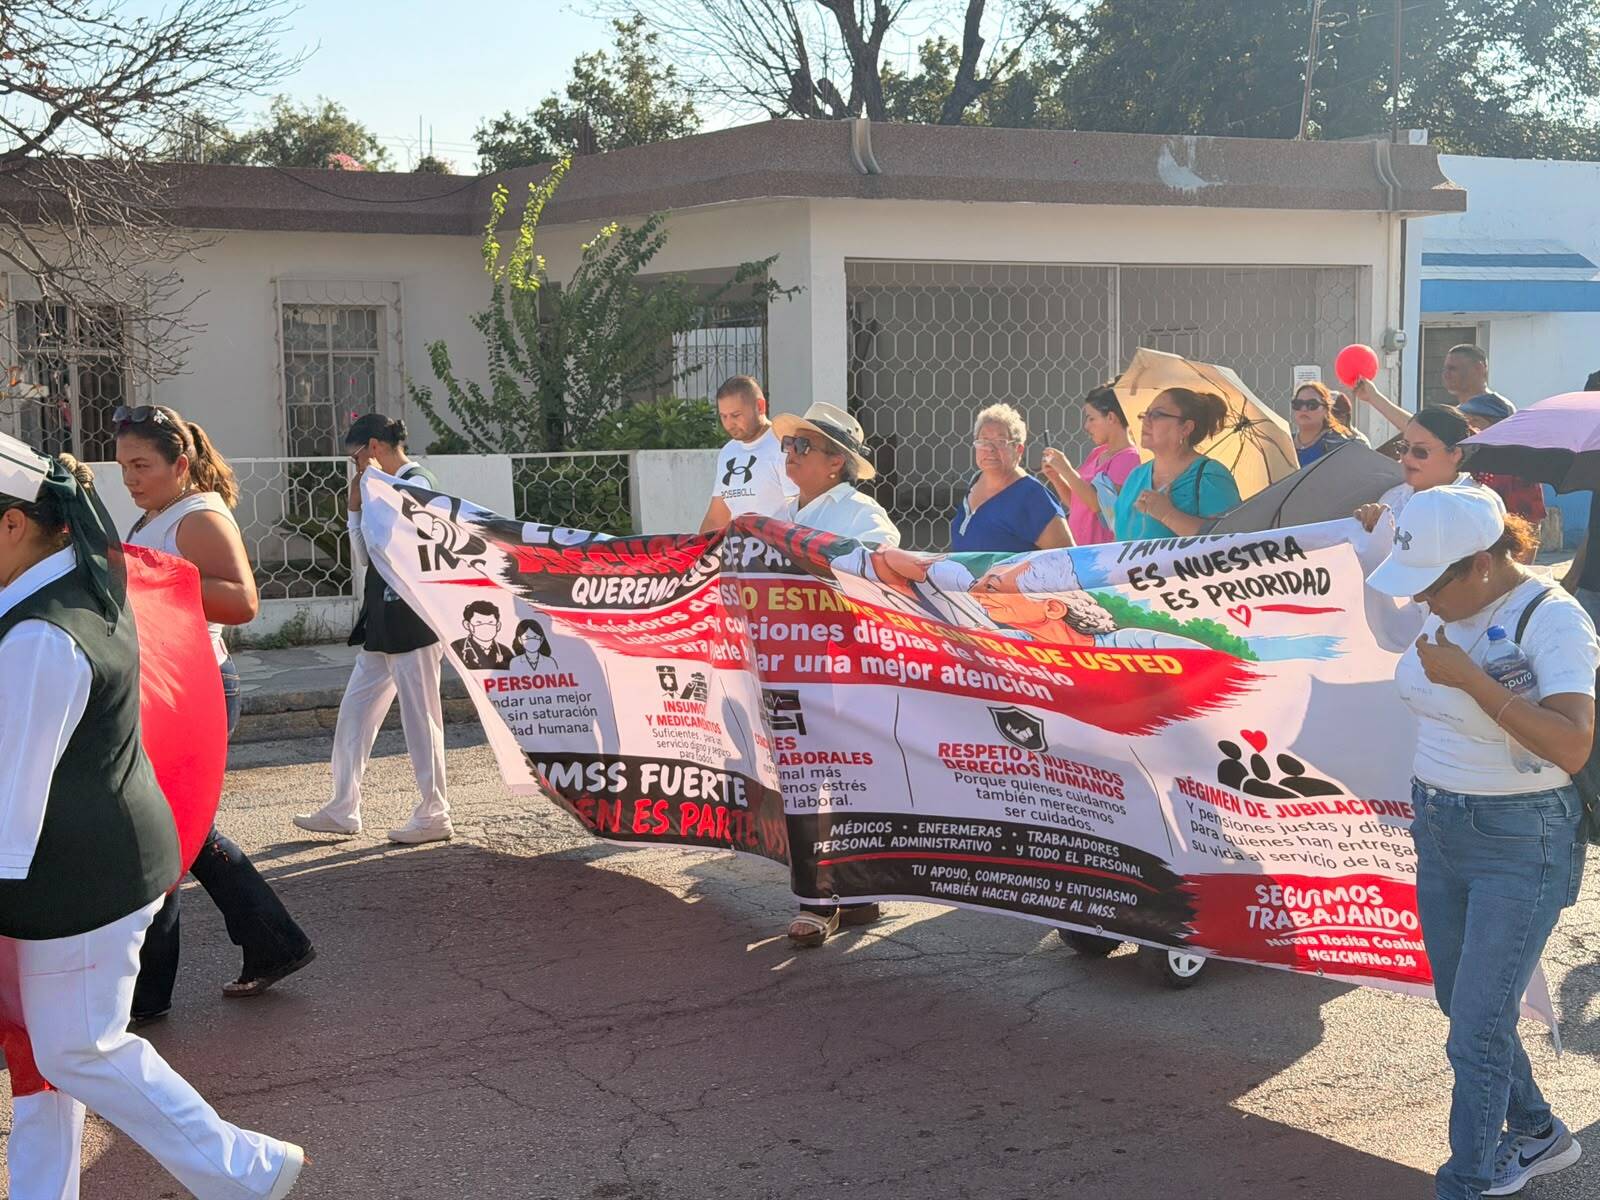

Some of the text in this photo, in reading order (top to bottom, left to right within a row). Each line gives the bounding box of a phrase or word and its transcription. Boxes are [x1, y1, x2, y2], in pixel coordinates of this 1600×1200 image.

[1127, 535, 1307, 592] ES NUESTRA
[572, 576, 681, 605] QUEREMO
[1160, 567, 1330, 612] ES PRIORIDAD
[853, 619, 938, 652] dignas
[941, 639, 973, 661] de
[974, 649, 1074, 686] trabajo
[1024, 645, 1072, 667] DE
[1072, 652, 1183, 675] USTED
[483, 673, 579, 693] PERSONAL
[794, 654, 851, 673] una
[861, 652, 933, 683] mejor
[940, 663, 1054, 701] atención
[507, 705, 598, 722] sin saturación
[529, 695, 552, 706] una
[556, 691, 592, 705] mejor
[538, 723, 593, 735] humana.
[645, 714, 653, 726] Y
[778, 751, 873, 765] ABORALES
[810, 766, 842, 778] más
[938, 743, 1124, 787] RESPETO A NUESTROS
[640, 764, 749, 809] FUERTE
[782, 779, 867, 794] enos estrés
[943, 759, 1125, 801] DERECHOS HUMANOS
[954, 771, 1127, 816] Porque quienes cuidamos
[793, 795, 853, 809] laboral.
[976, 786, 1115, 824] también merecemos
[1175, 776, 1242, 816] RÉGIMEN
[1244, 799, 1272, 819] DE
[632, 799, 669, 836] ES
[680, 801, 758, 848] PARTE
[1004, 806, 1096, 833] ser cuidados.
[1186, 800, 1413, 838] Y pensiones justas y digna
[830, 821, 1120, 858] MÉDICOS ENFERMERAS TRABAJADORES
[1190, 820, 1220, 841] para
[1222, 833, 1295, 848] quienes
[1299, 835, 1333, 850] han
[813, 836, 886, 855] PERSONAL
[890, 836, 992, 852] ADMINISTRATIVO
[1029, 845, 1061, 861] TODO
[1065, 851, 1080, 864] EL
[1084, 853, 1144, 879] PERSONAL
[1192, 840, 1207, 854] su
[1209, 845, 1246, 861] vida
[1248, 850, 1265, 862] al
[1269, 851, 1337, 870] servicio
[1343, 856, 1369, 868] de
[1372, 854, 1391, 870] la
[911, 864, 926, 877] TU
[975, 870, 1051, 891] COMPROMISO
[1067, 883, 1138, 907] ENTUSIASMO
[930, 880, 1118, 920] TAMBIÉN HACEN GRANDE AL IMSS.
[1254, 884, 1384, 910] SEGUIMOS
[1246, 905, 1418, 931] TRABAJANDO
[1265, 935, 1316, 948] Nueva
[1319, 933, 1370, 948] Rosita
